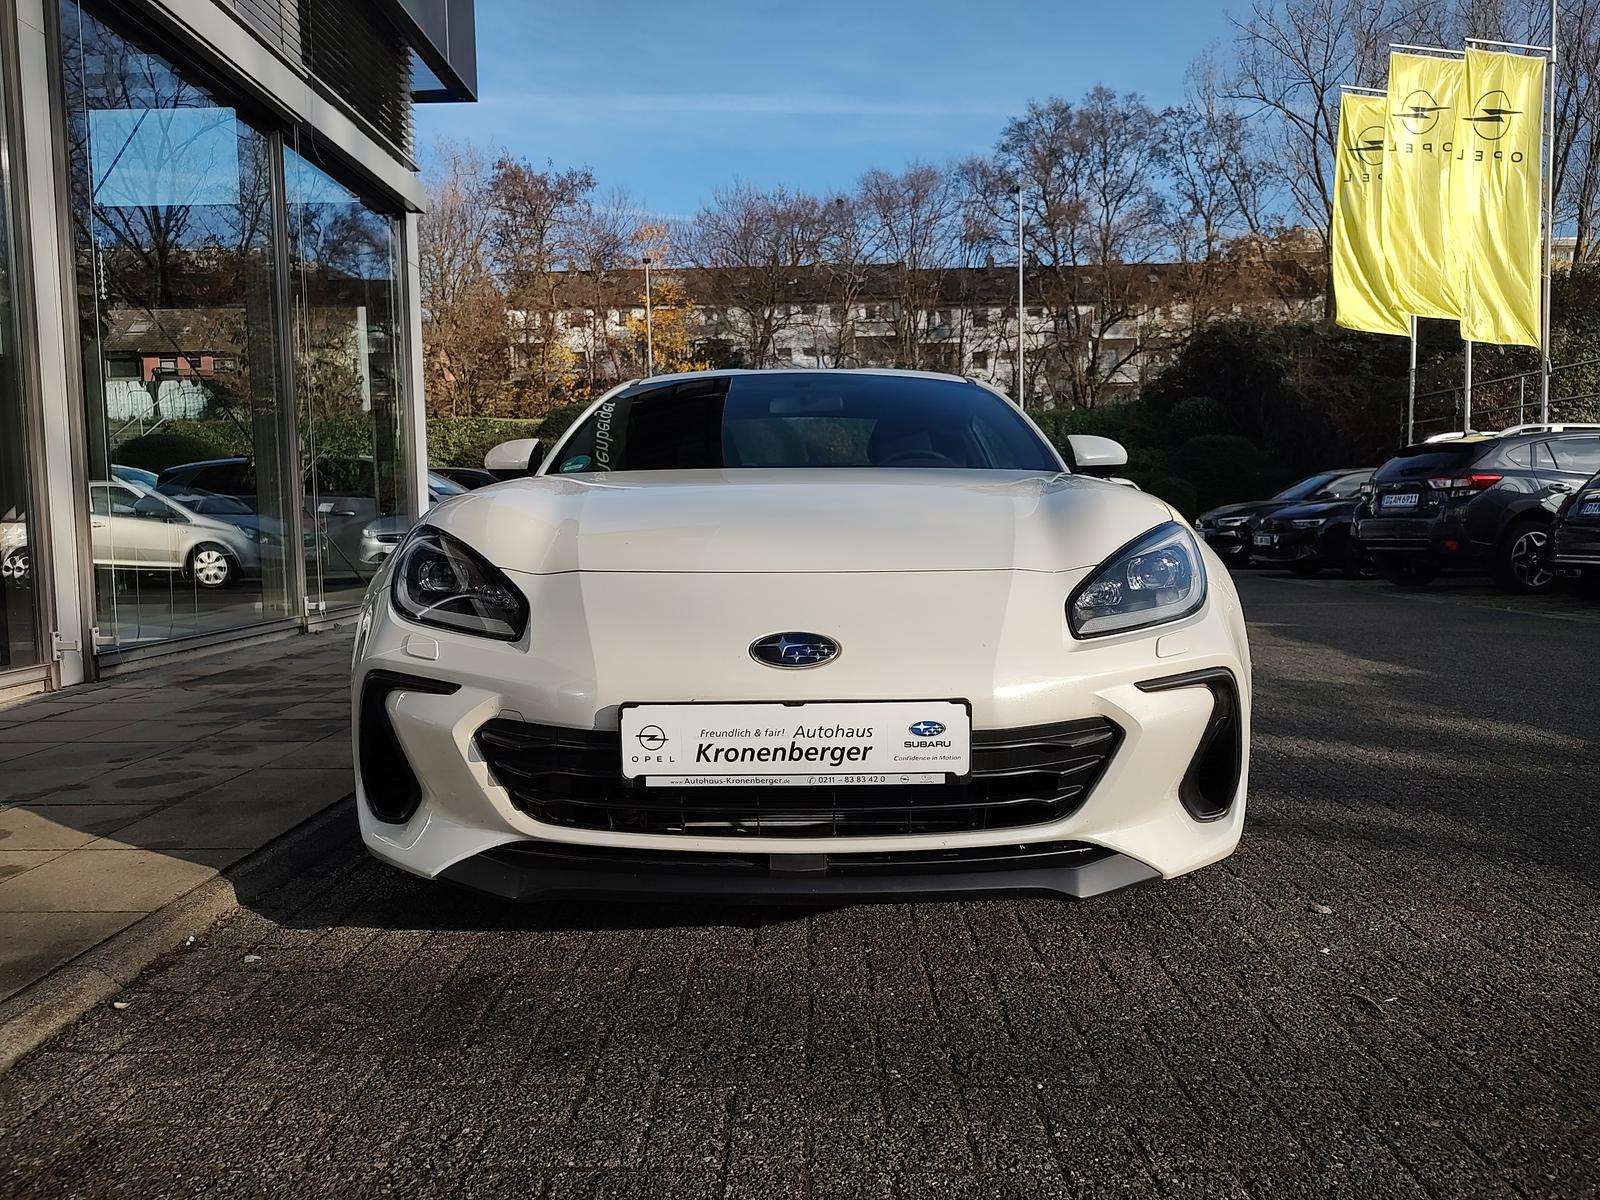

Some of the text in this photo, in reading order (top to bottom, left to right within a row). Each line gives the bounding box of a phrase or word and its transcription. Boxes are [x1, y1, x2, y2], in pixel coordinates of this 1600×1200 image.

[700, 727, 786, 739] Freundlich & fair!
[792, 724, 874, 739] Autohaus
[903, 740, 952, 748] SUBARU
[695, 741, 873, 767] Kronenberger
[631, 755, 676, 764] OPEL
[818, 775, 836, 784] 0211
[844, 775, 855, 784] 83
[856, 775, 867, 784] 83
[868, 775, 879, 784] 42
